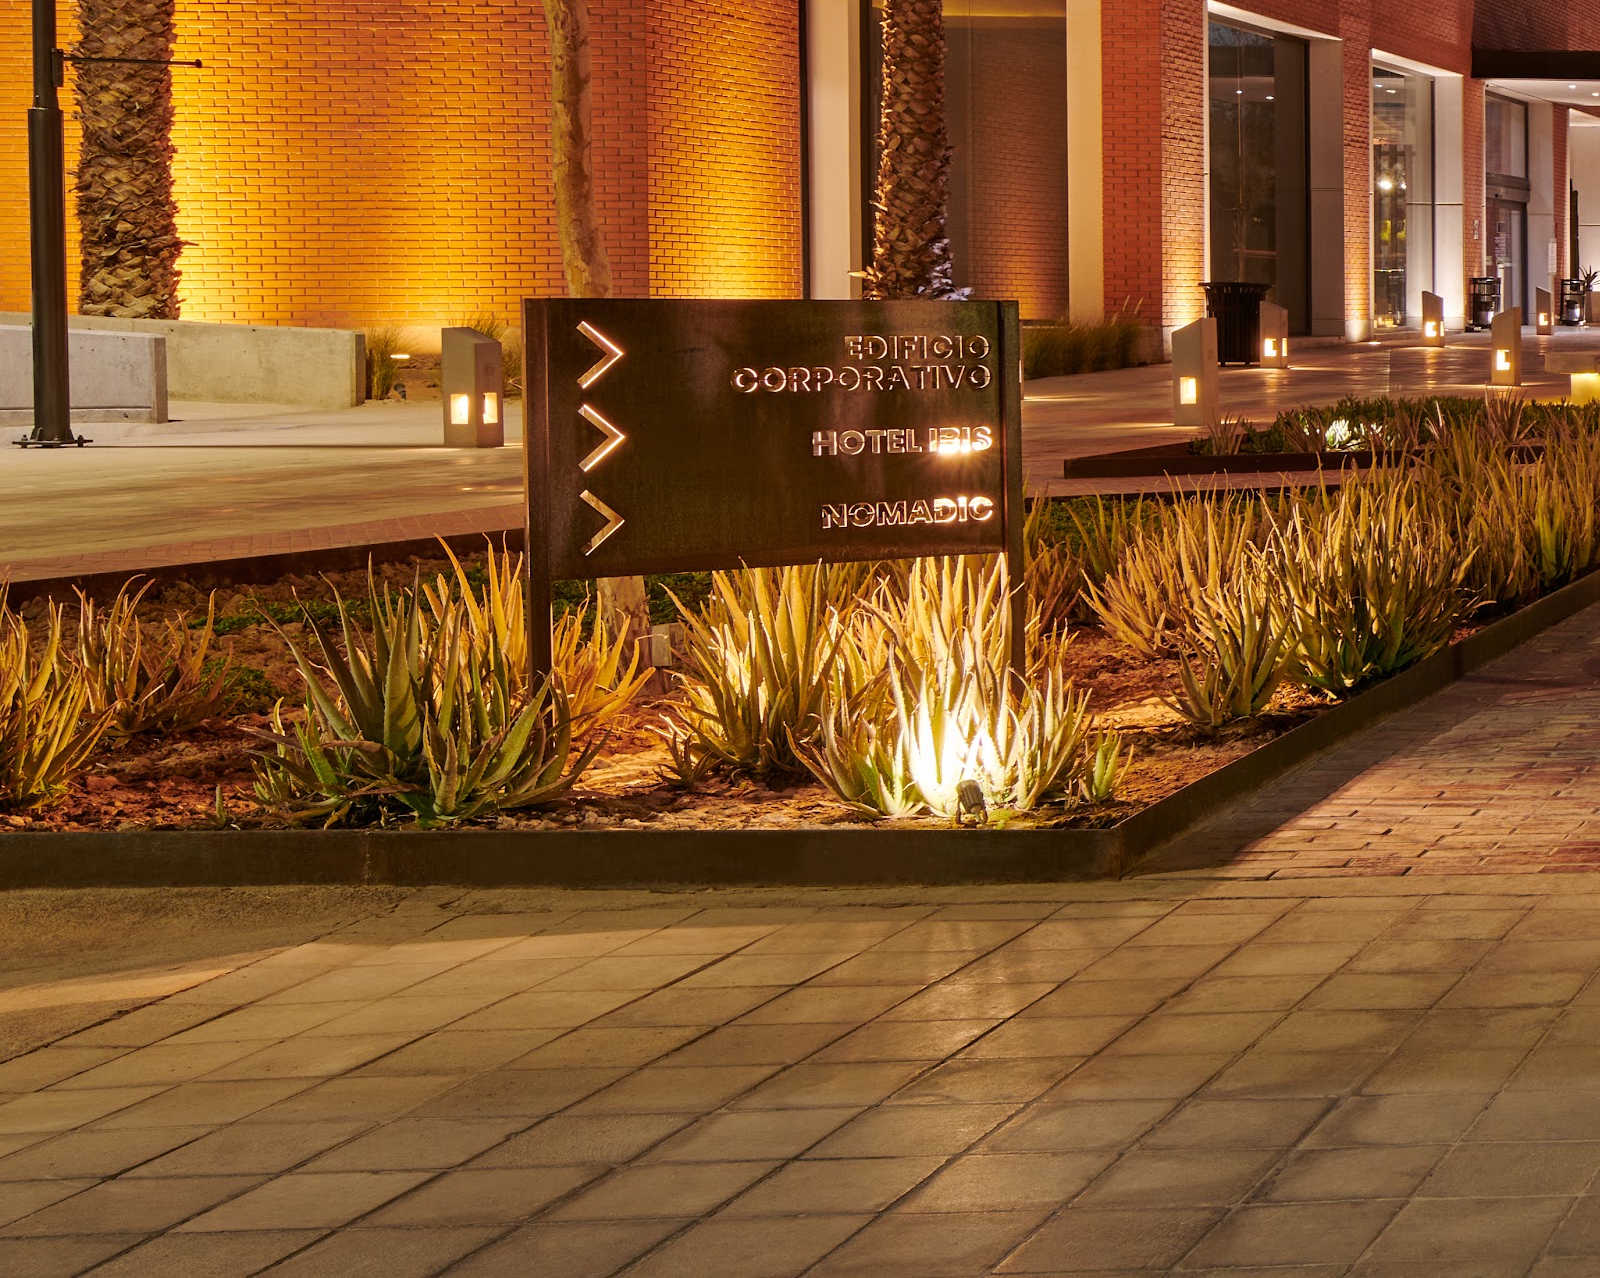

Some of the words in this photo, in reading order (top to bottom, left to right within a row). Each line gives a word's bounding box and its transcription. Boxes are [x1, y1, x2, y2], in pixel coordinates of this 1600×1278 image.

[845, 335, 990, 360] EDIFICIO
[731, 365, 992, 393] CORPORATIVO
[812, 429, 922, 456] HOTEL
[928, 426, 993, 454] IBIS
[822, 496, 993, 529] NOMADIC
